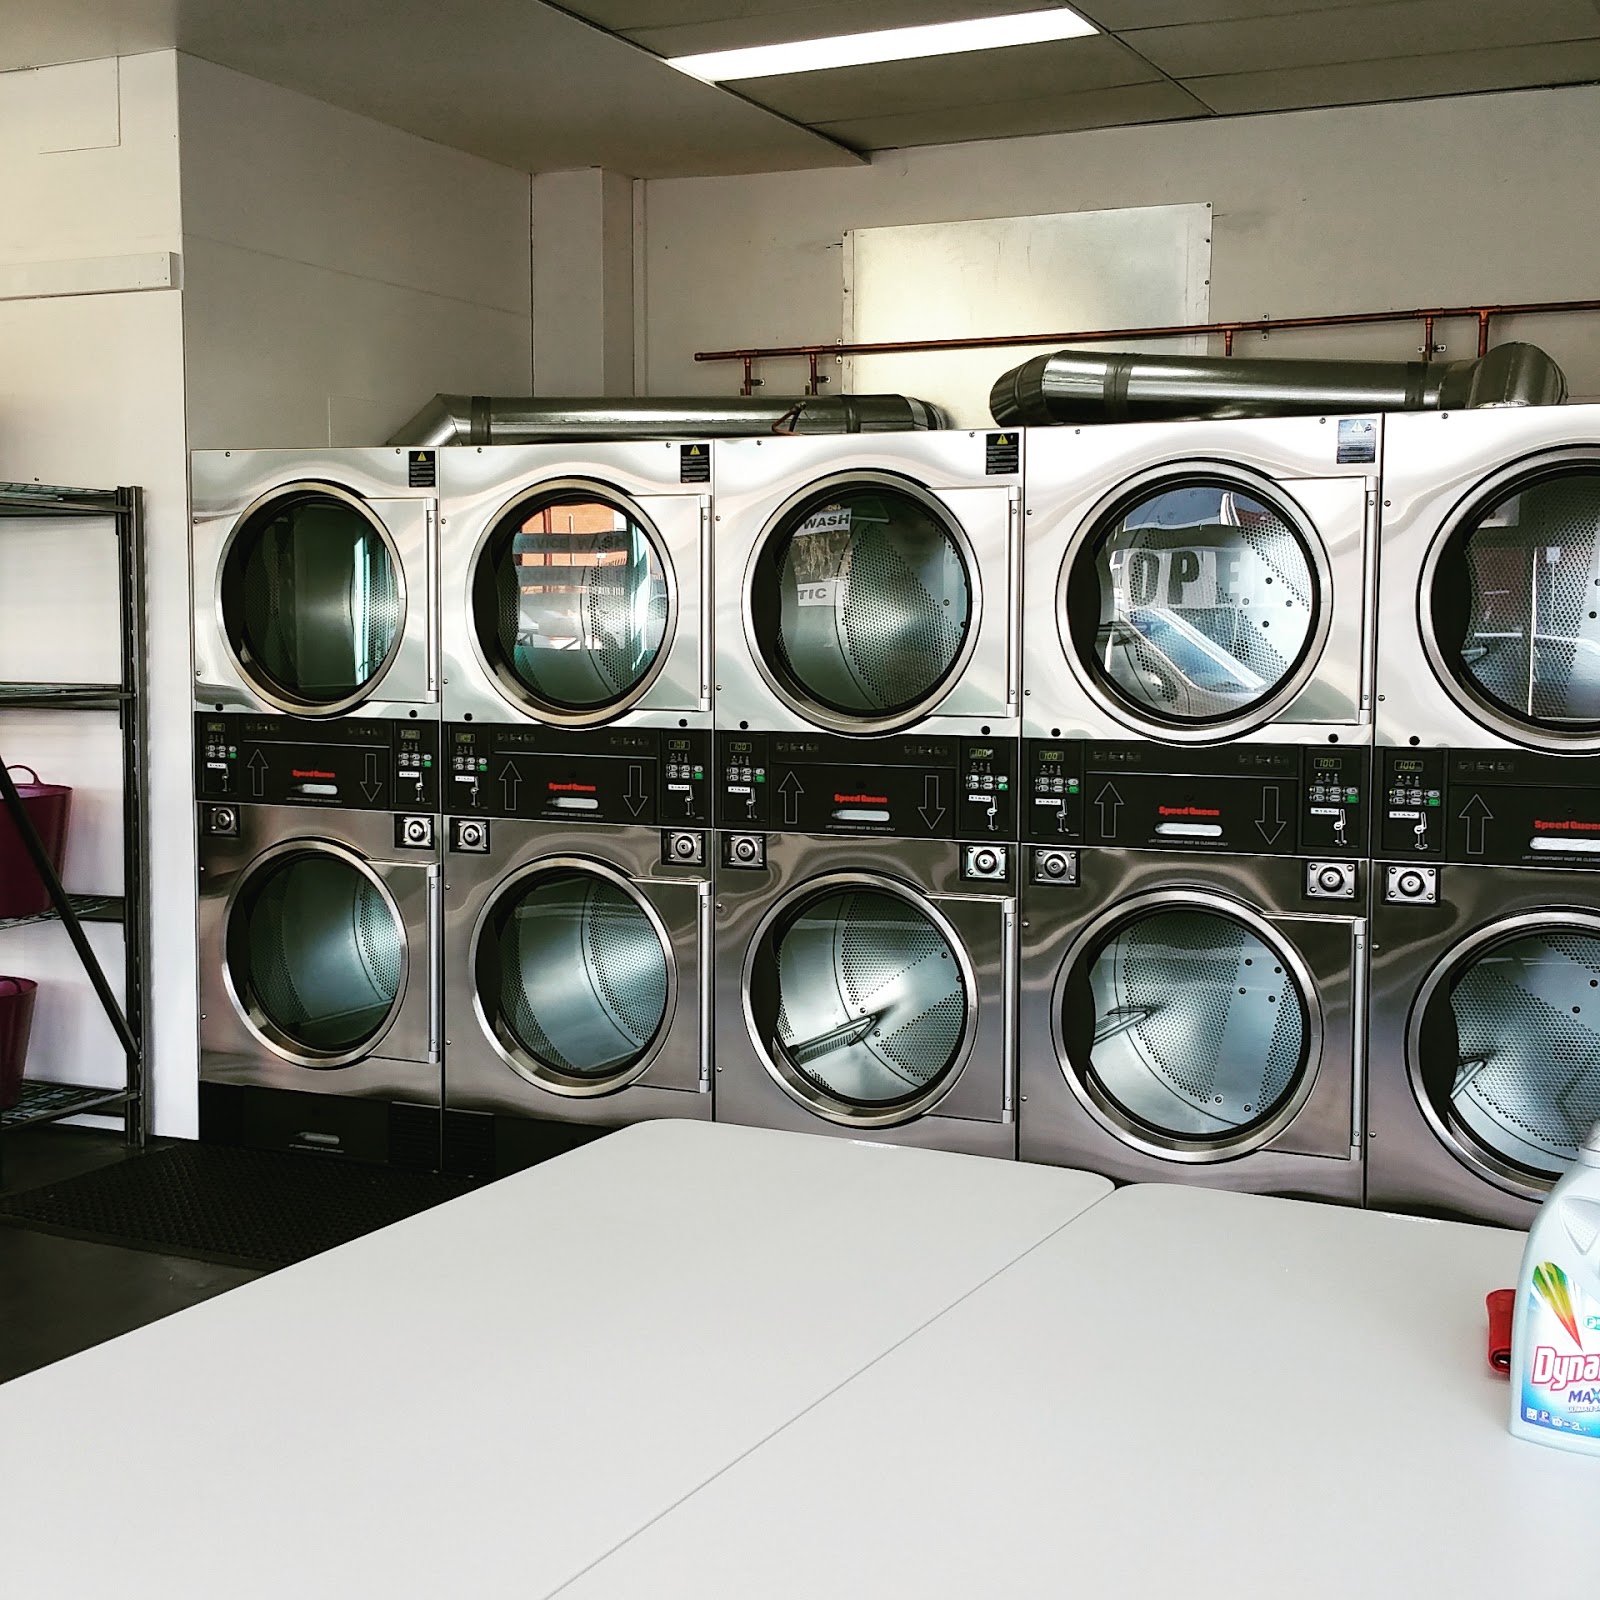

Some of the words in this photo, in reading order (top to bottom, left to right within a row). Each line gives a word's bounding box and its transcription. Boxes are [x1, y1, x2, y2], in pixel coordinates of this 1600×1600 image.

[803, 513, 850, 530] WASH
[834, 794, 860, 803] Speed
[861, 794, 888, 803] Queen
[1158, 806, 1188, 816] Speed
[1190, 807, 1220, 816] Queen
[1534, 820, 1569, 831] Speed
